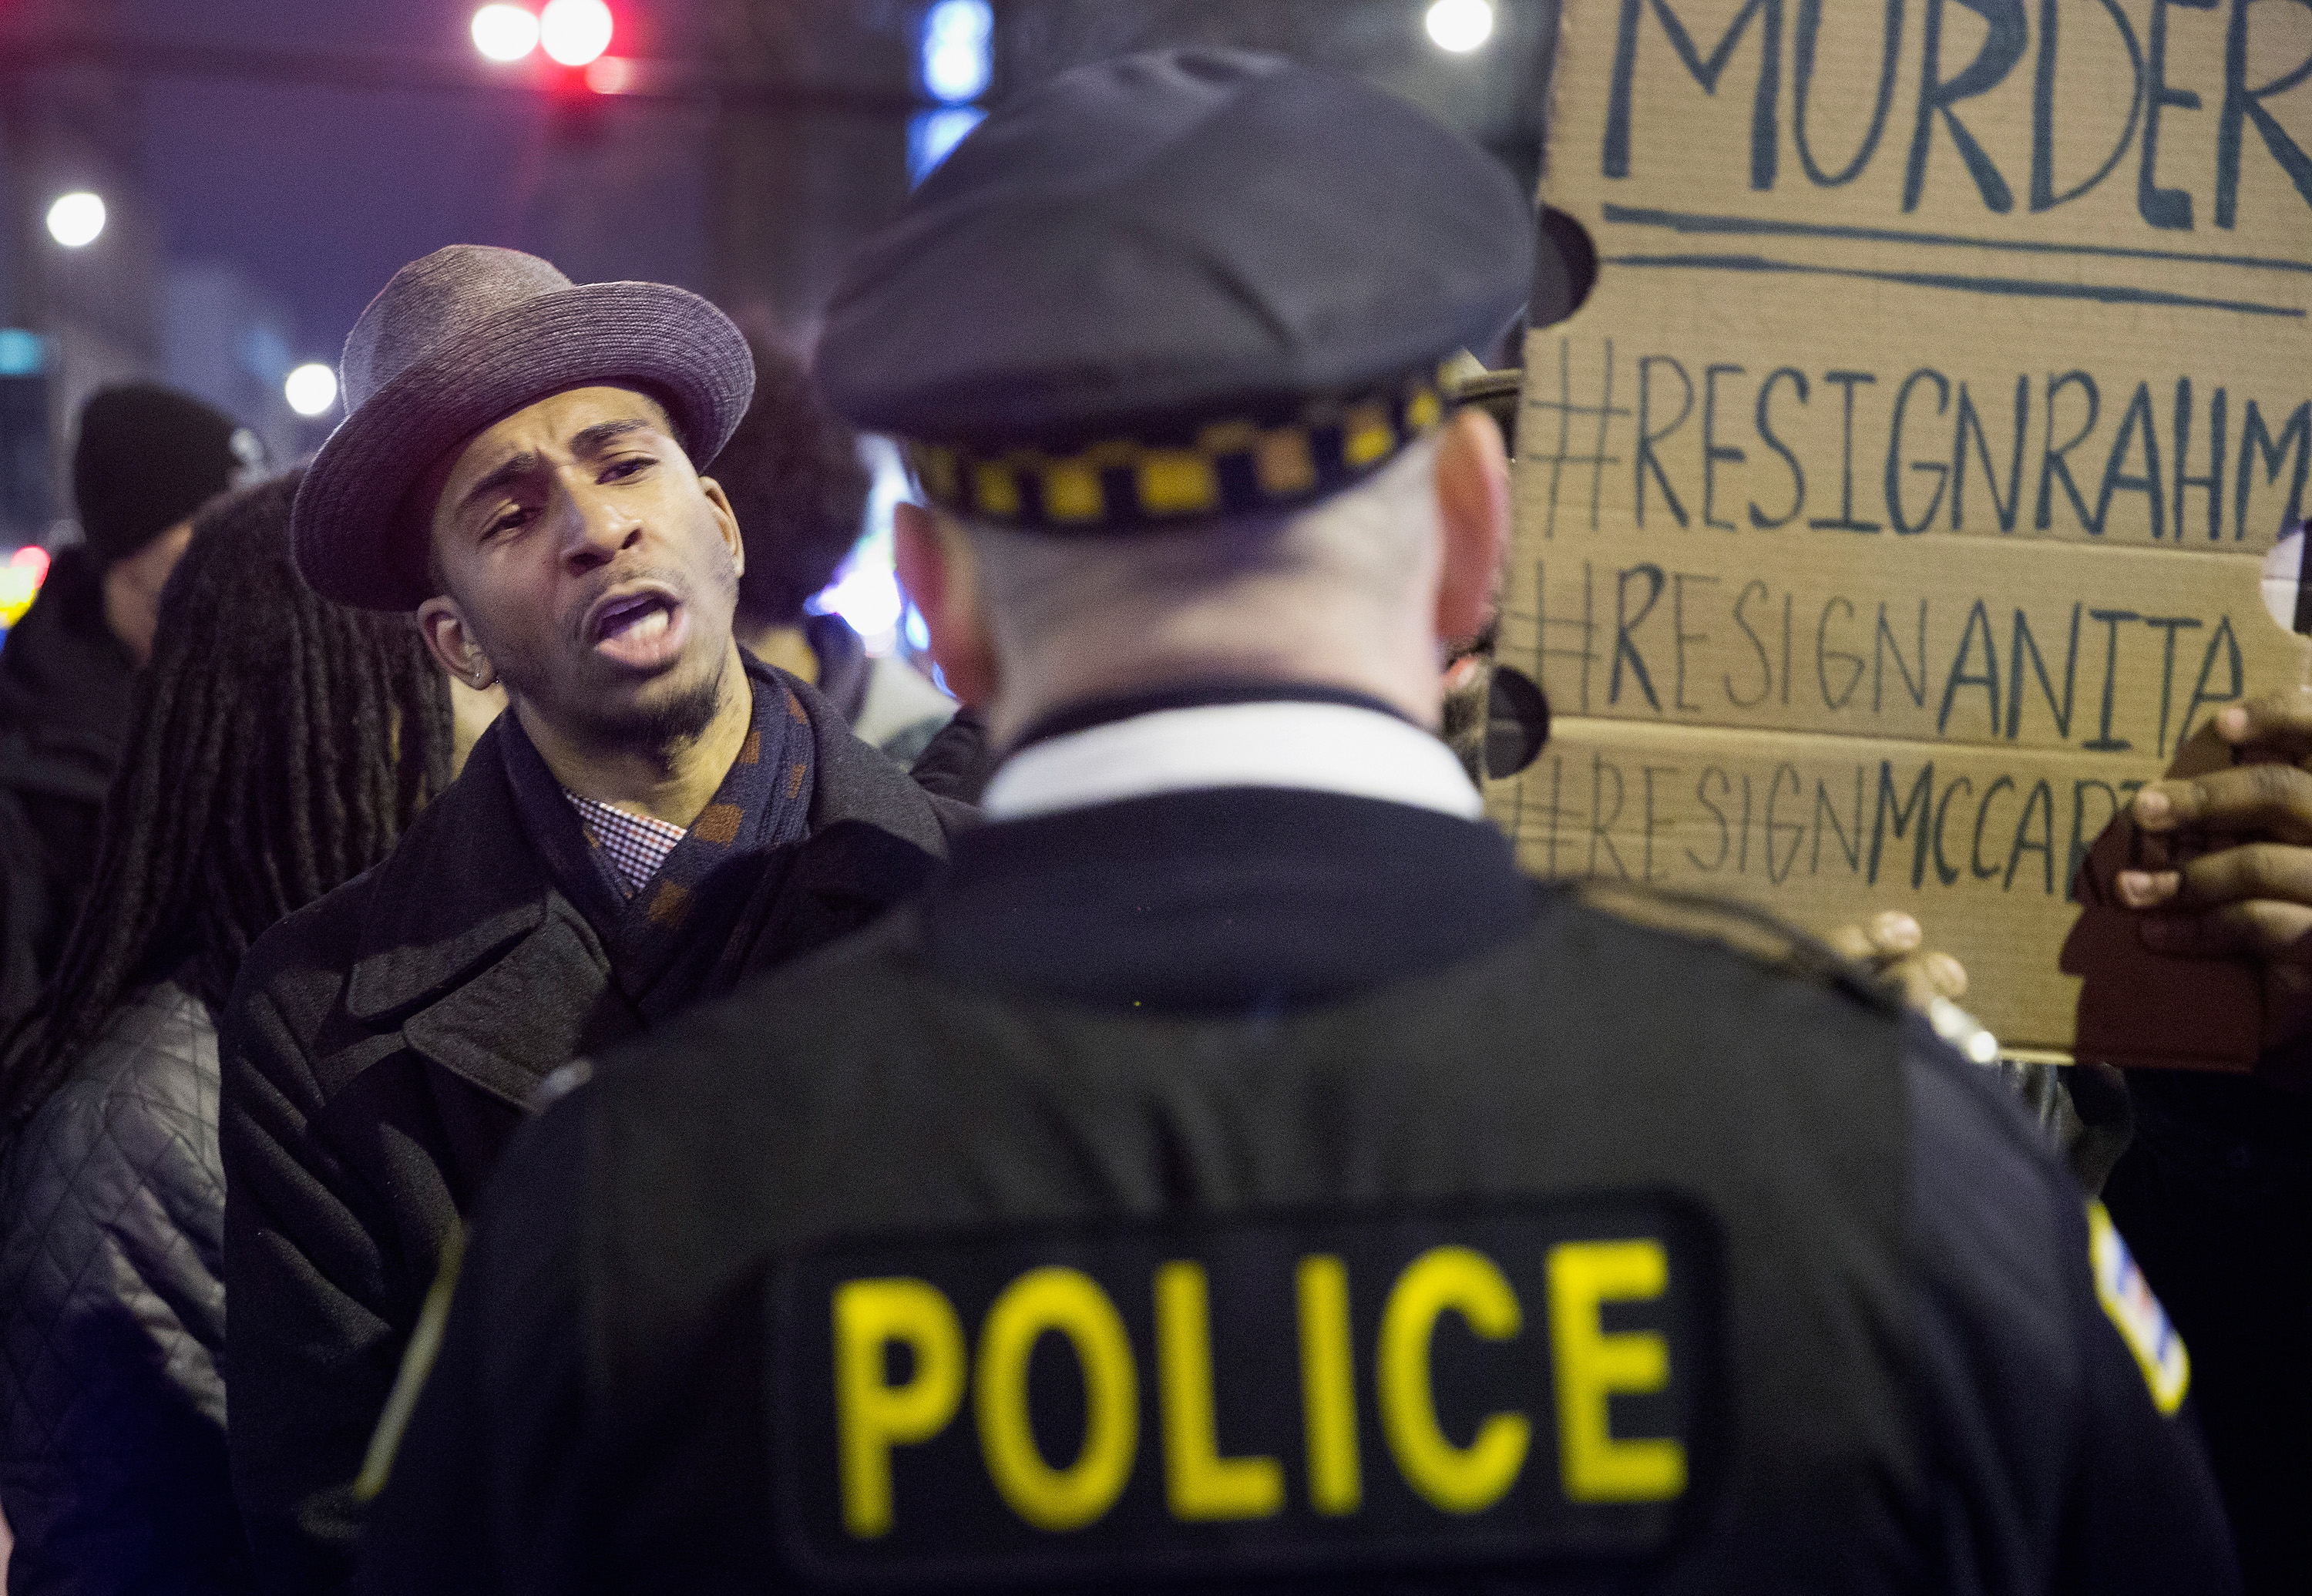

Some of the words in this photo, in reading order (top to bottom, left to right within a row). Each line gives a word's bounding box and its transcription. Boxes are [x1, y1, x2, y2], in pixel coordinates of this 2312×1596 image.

[1601, 0, 2312, 230] MURDER
[1528, 338, 2312, 541] #RESIGNRAHM
[1501, 559, 2244, 759] #RESIGNANITA
[1495, 751, 2147, 902] #RESIGNMCCAR
[832, 1239, 1688, 1538] POLICE
